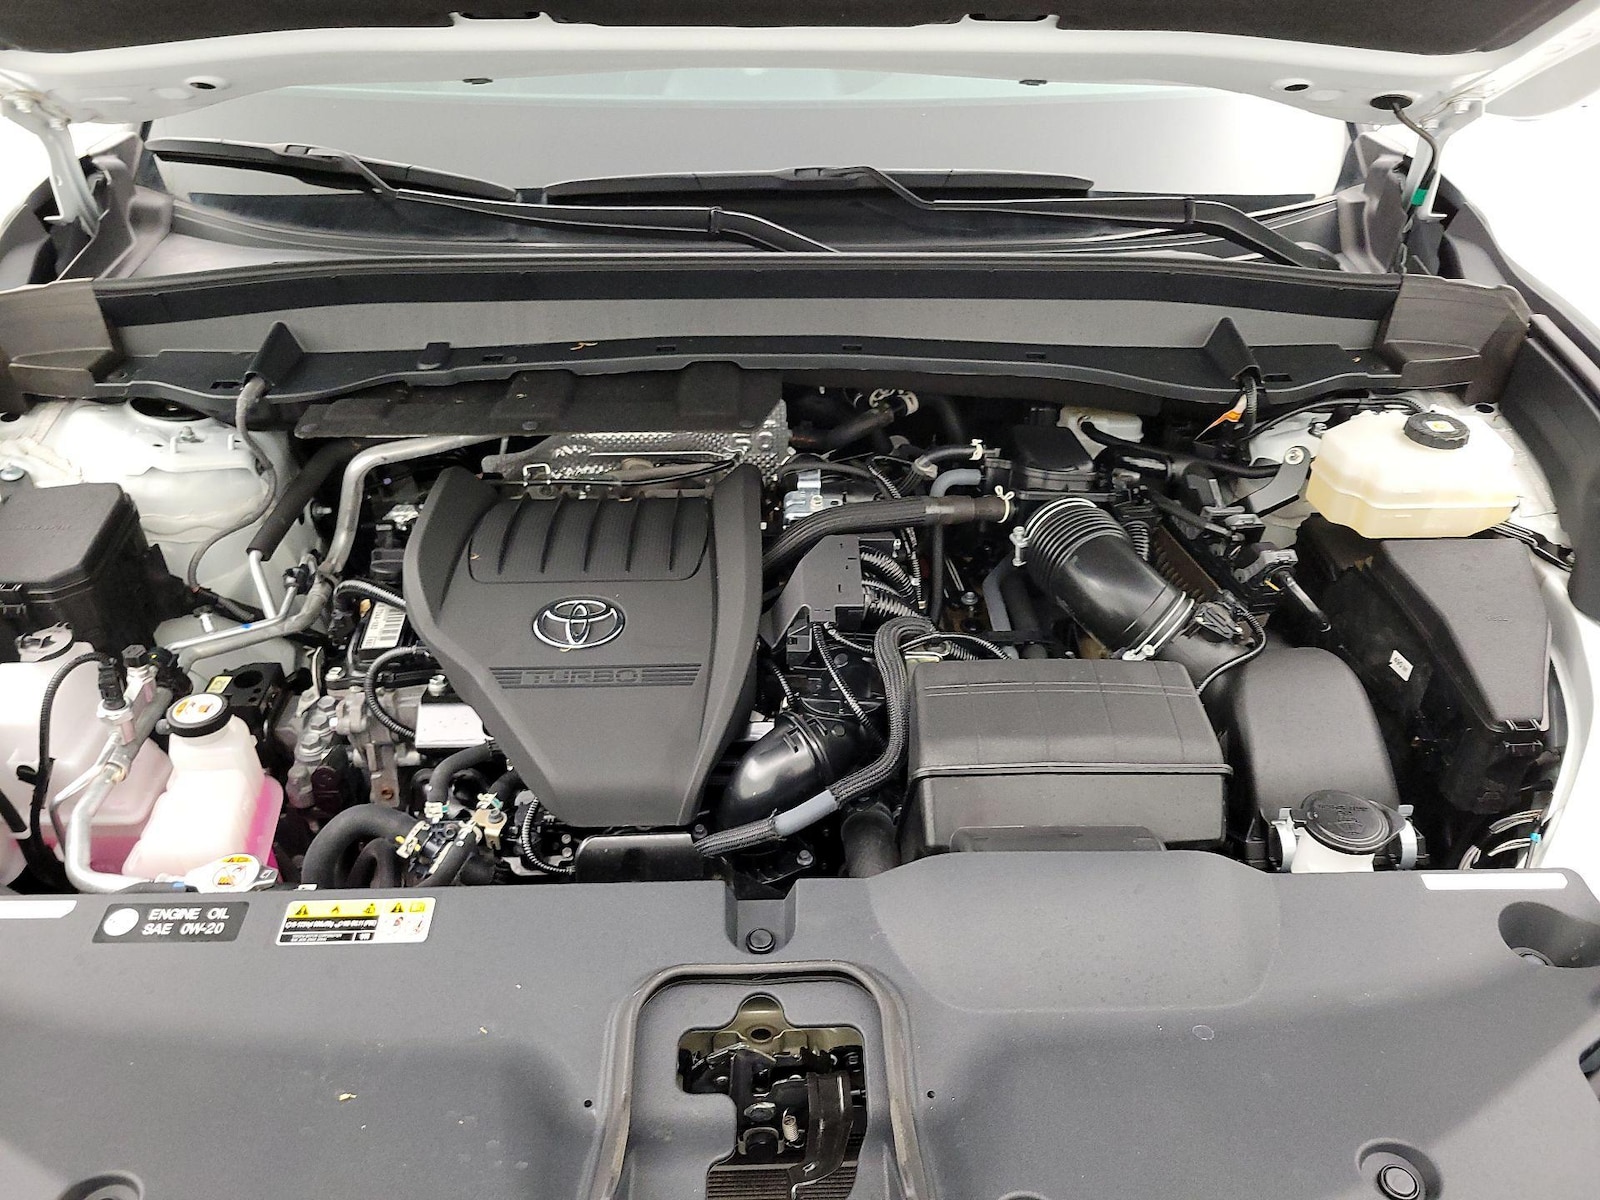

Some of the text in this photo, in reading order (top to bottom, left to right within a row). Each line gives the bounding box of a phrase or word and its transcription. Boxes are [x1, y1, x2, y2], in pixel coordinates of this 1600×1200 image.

[521, 669, 642, 685] TURBO
[148, 907, 230, 921] ENGINE OIL
[141, 922, 225, 936] SAE 0W-20
